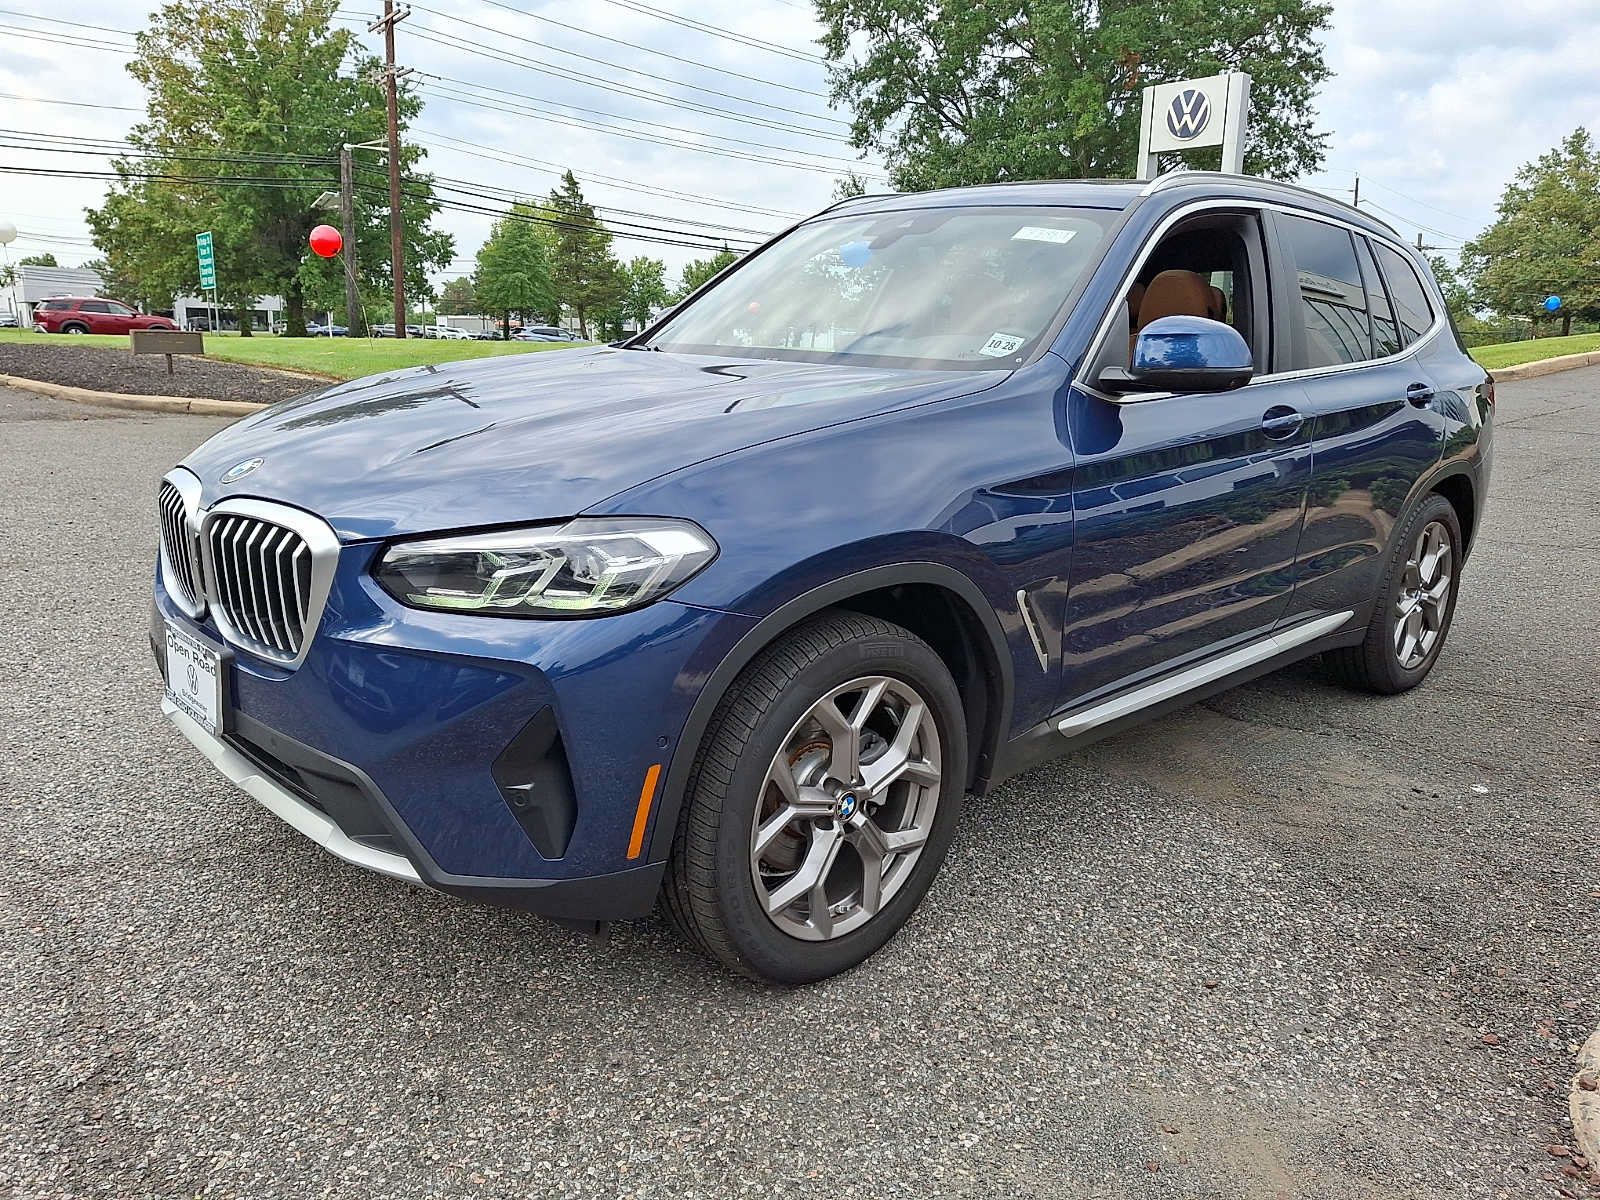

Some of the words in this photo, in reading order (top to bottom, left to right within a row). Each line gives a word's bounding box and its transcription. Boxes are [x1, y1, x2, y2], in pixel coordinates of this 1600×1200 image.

[1167, 89, 1210, 139] VW
[988, 340, 1001, 348] 10
[1002, 342, 1016, 350] 28
[167, 635, 190, 659] Open
[193, 651, 216, 676] Road
